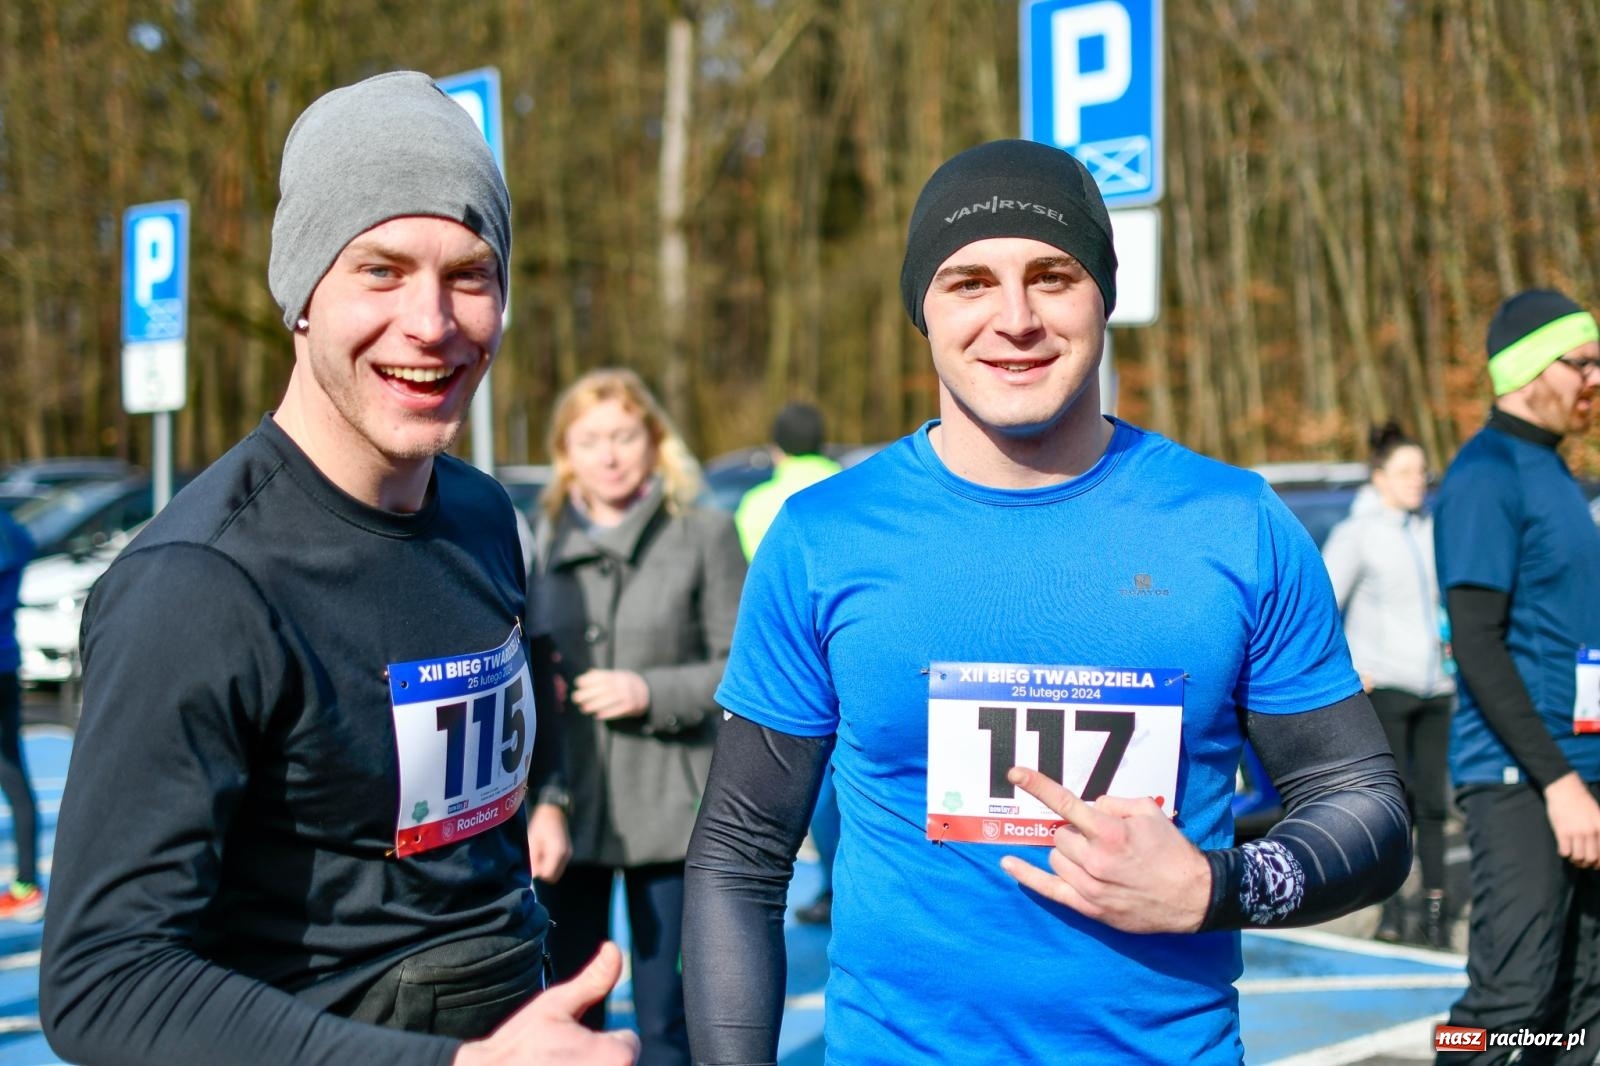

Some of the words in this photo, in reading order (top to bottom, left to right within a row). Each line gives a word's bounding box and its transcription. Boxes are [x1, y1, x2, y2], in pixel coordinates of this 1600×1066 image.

[1052, 1, 1132, 148] P
[134, 216, 175, 308] P
[418, 663, 443, 683] XII
[446, 658, 481, 679] BIEG
[468, 676, 479, 689] 25
[480, 671, 502, 686] lutego
[959, 667, 983, 683] XII
[987, 668, 1030, 684] BIEG
[1030, 669, 1155, 688] TWARDZIELA
[1012, 686, 1027, 697] 25
[1029, 687, 1069, 701] lutego
[1072, 688, 1101, 699] 2024
[436, 676, 525, 800] 115
[978, 707, 1135, 802] 117
[457, 807, 498, 831] Racibórz
